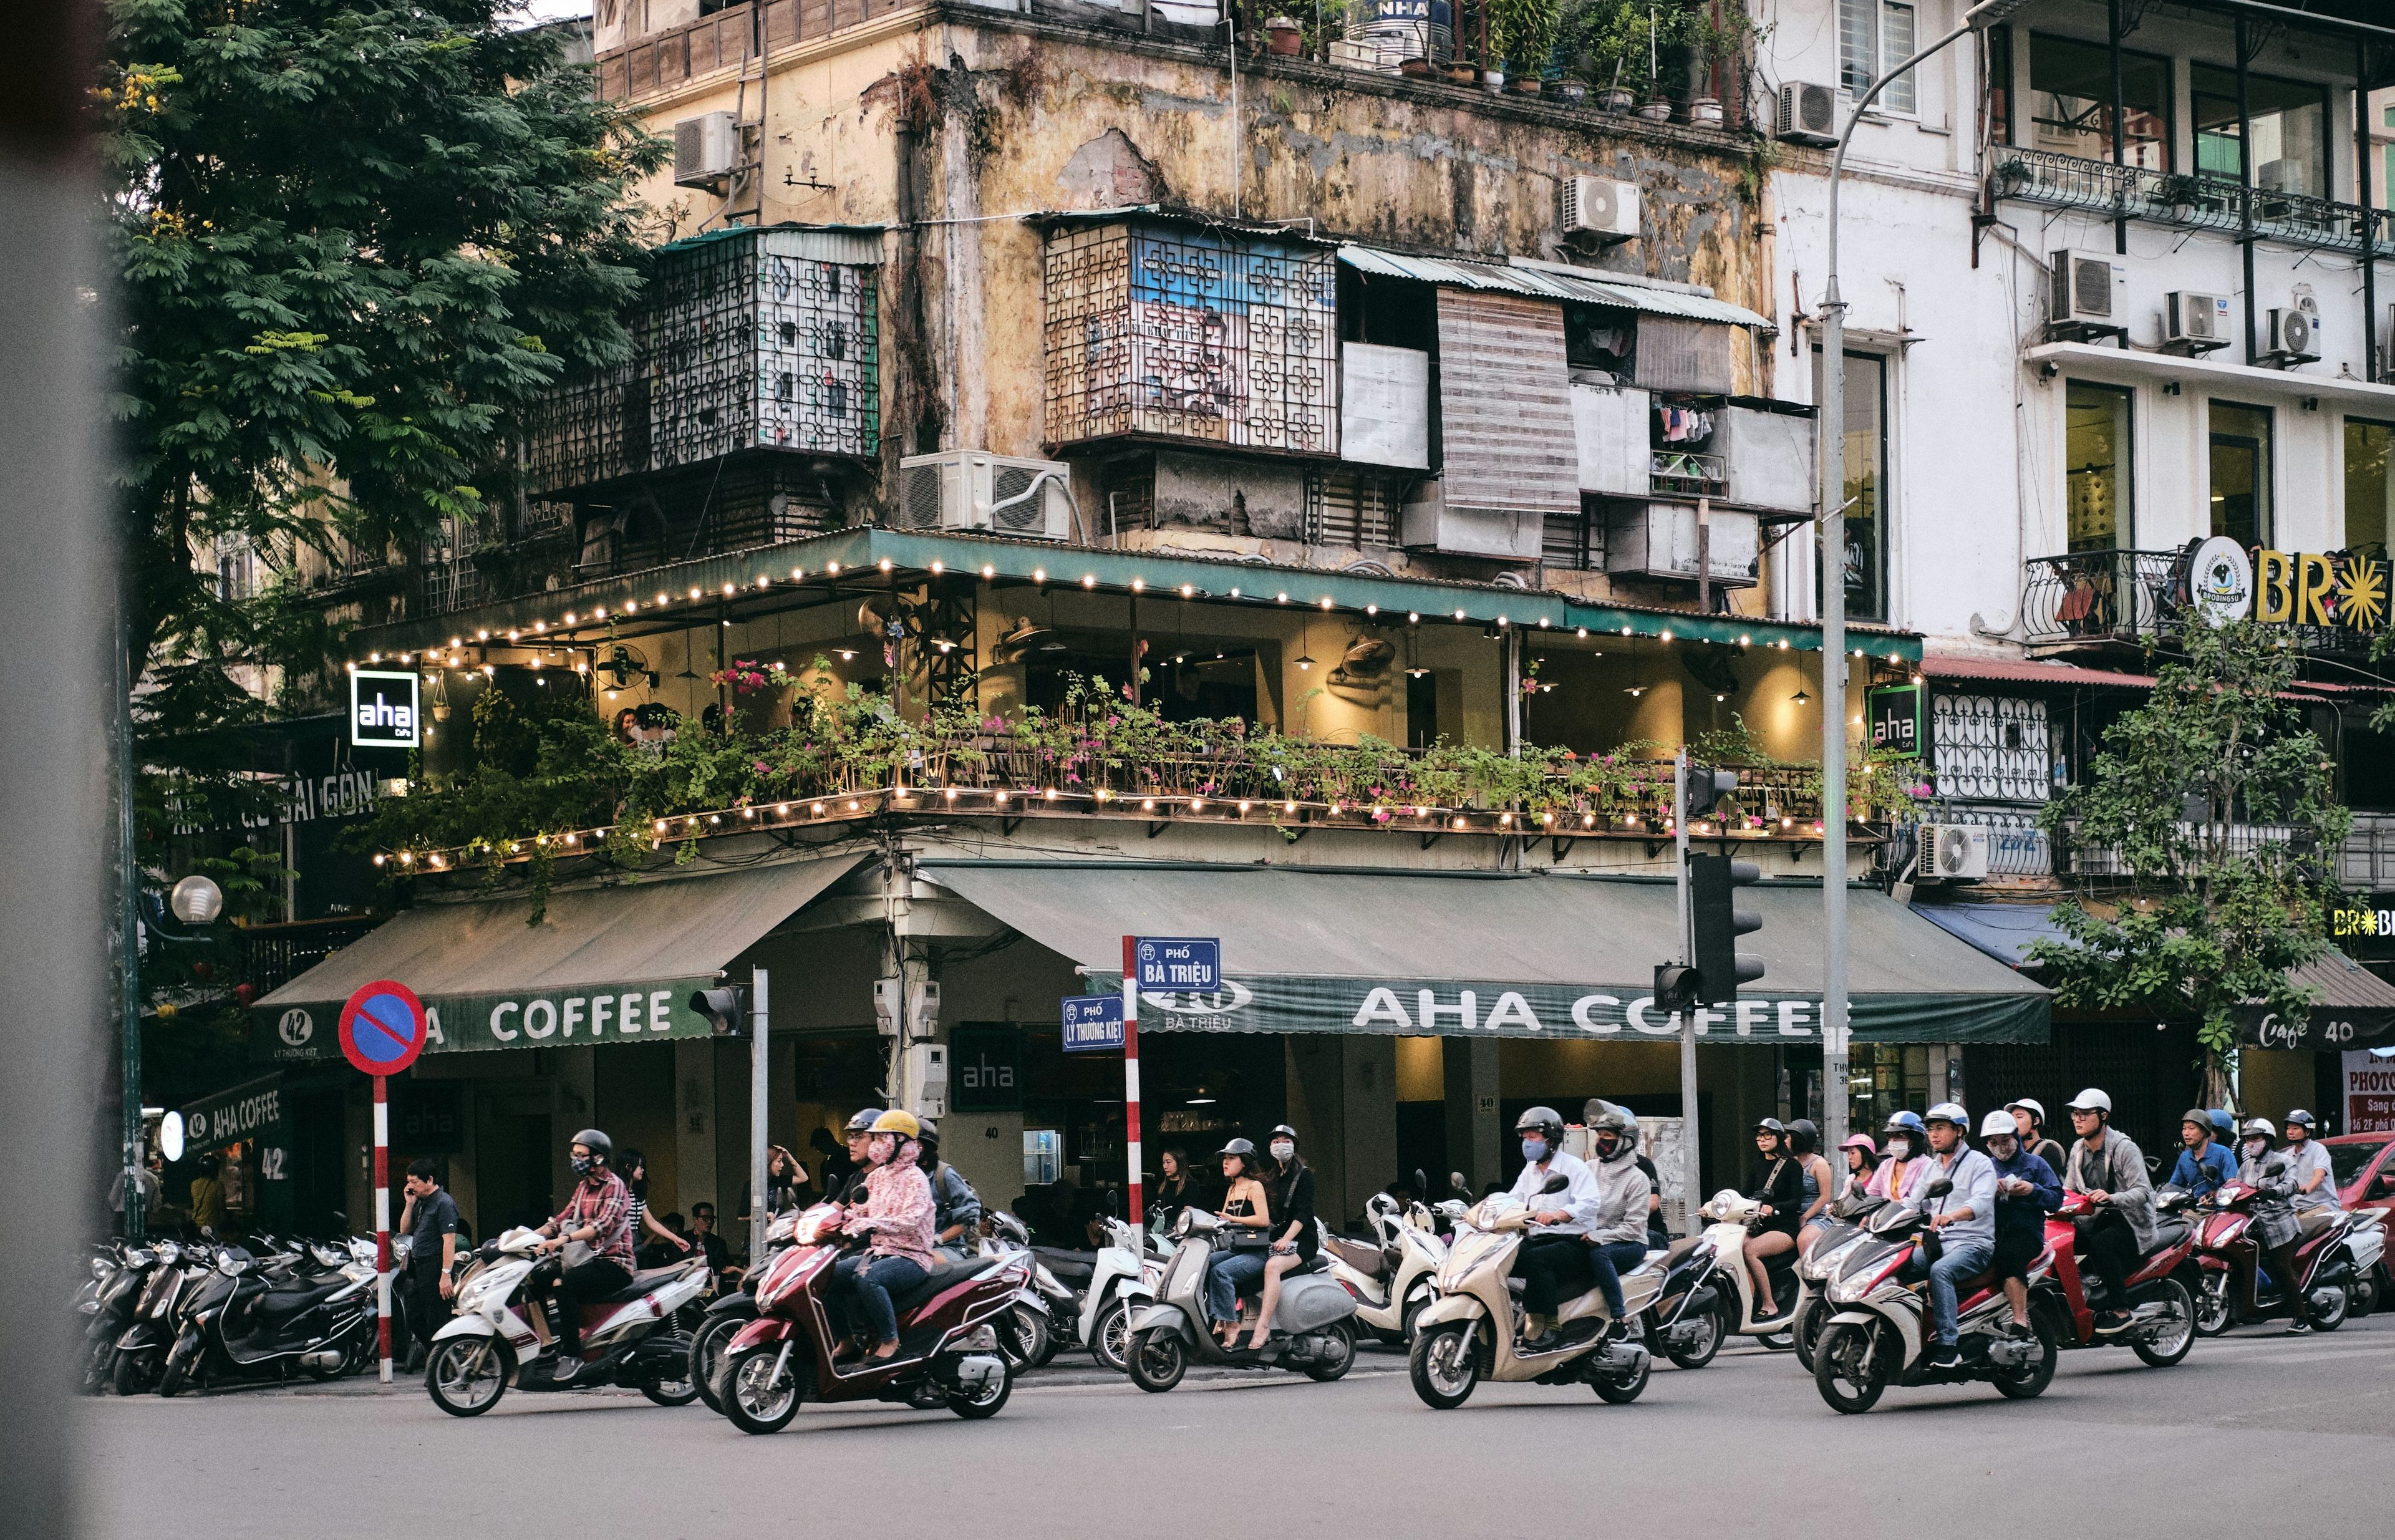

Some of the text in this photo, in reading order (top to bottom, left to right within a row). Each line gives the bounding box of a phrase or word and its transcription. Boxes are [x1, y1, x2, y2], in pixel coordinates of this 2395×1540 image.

[2203, 591, 2239, 603] BROBINGSU
[359, 692, 412, 727] aha
[1874, 708, 1914, 741] aha
[1166, 945, 1190, 959] PHỐ
[1145, 960, 1211, 986] BÀ TRIỆU
[490, 990, 672, 1042] COFFEE
[1083, 1001, 1103, 1017] PHỐ
[1352, 987, 1854, 1037] AHA COFFE
[286, 1011, 306, 1041] 42
[1067, 1017, 1122, 1042] LÝ THƯỜNG KIỆT
[1166, 1014, 1231, 1030] BÀ TRIỆU
[2325, 1021, 2354, 1042] 40
[963, 1053, 1014, 1088] aha
[1480, 1097, 1494, 1108] 40
[2368, 1098, 2389, 1114] Sang
[214, 1090, 280, 1141] AHA COFFEE
[985, 1127, 998, 1139] 40
[262, 1148, 284, 1180] 42
